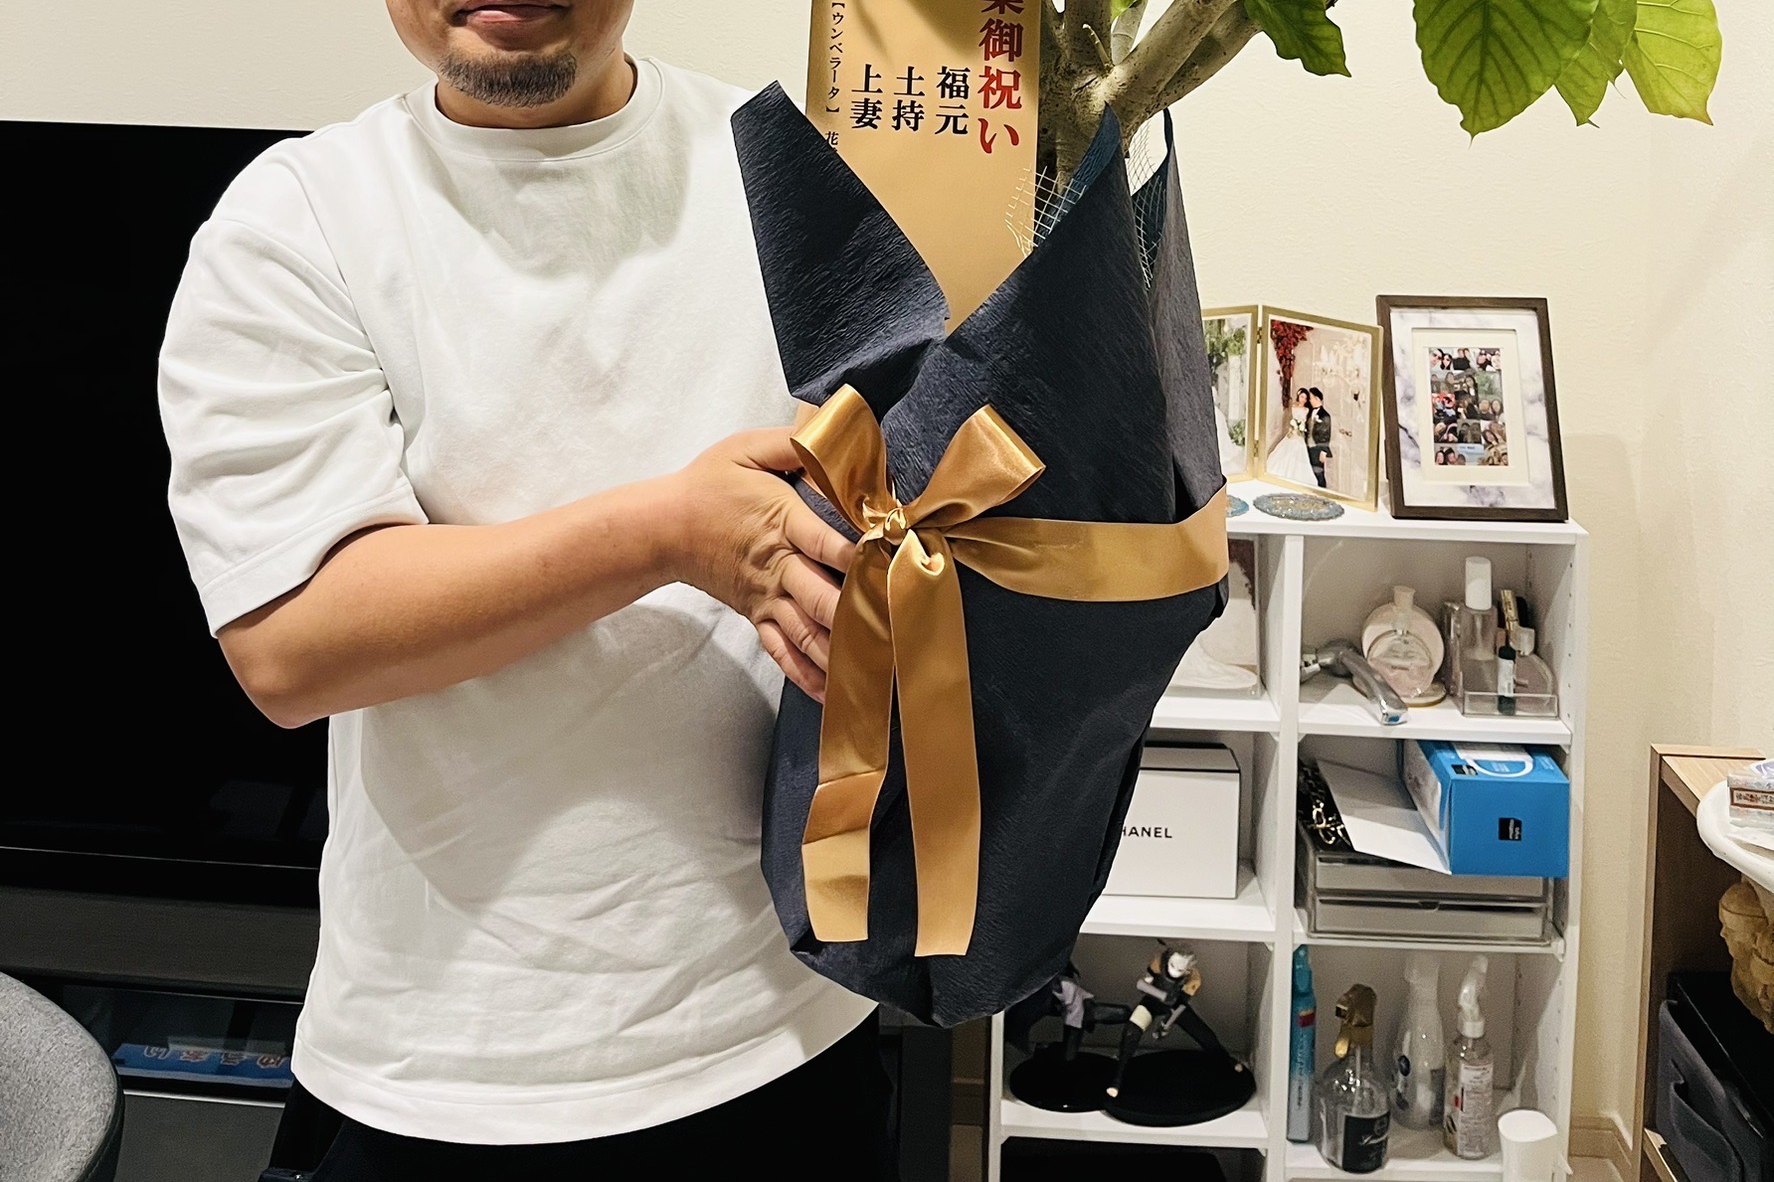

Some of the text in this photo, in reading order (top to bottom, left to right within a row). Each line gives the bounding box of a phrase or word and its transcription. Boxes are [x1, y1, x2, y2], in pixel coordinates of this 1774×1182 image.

[826, 2, 845, 113] 【ウンベラータ】
[850, 64, 883, 130] 上妻
[892, 66, 925, 132] 土持
[935, 66, 970, 135] 福元
